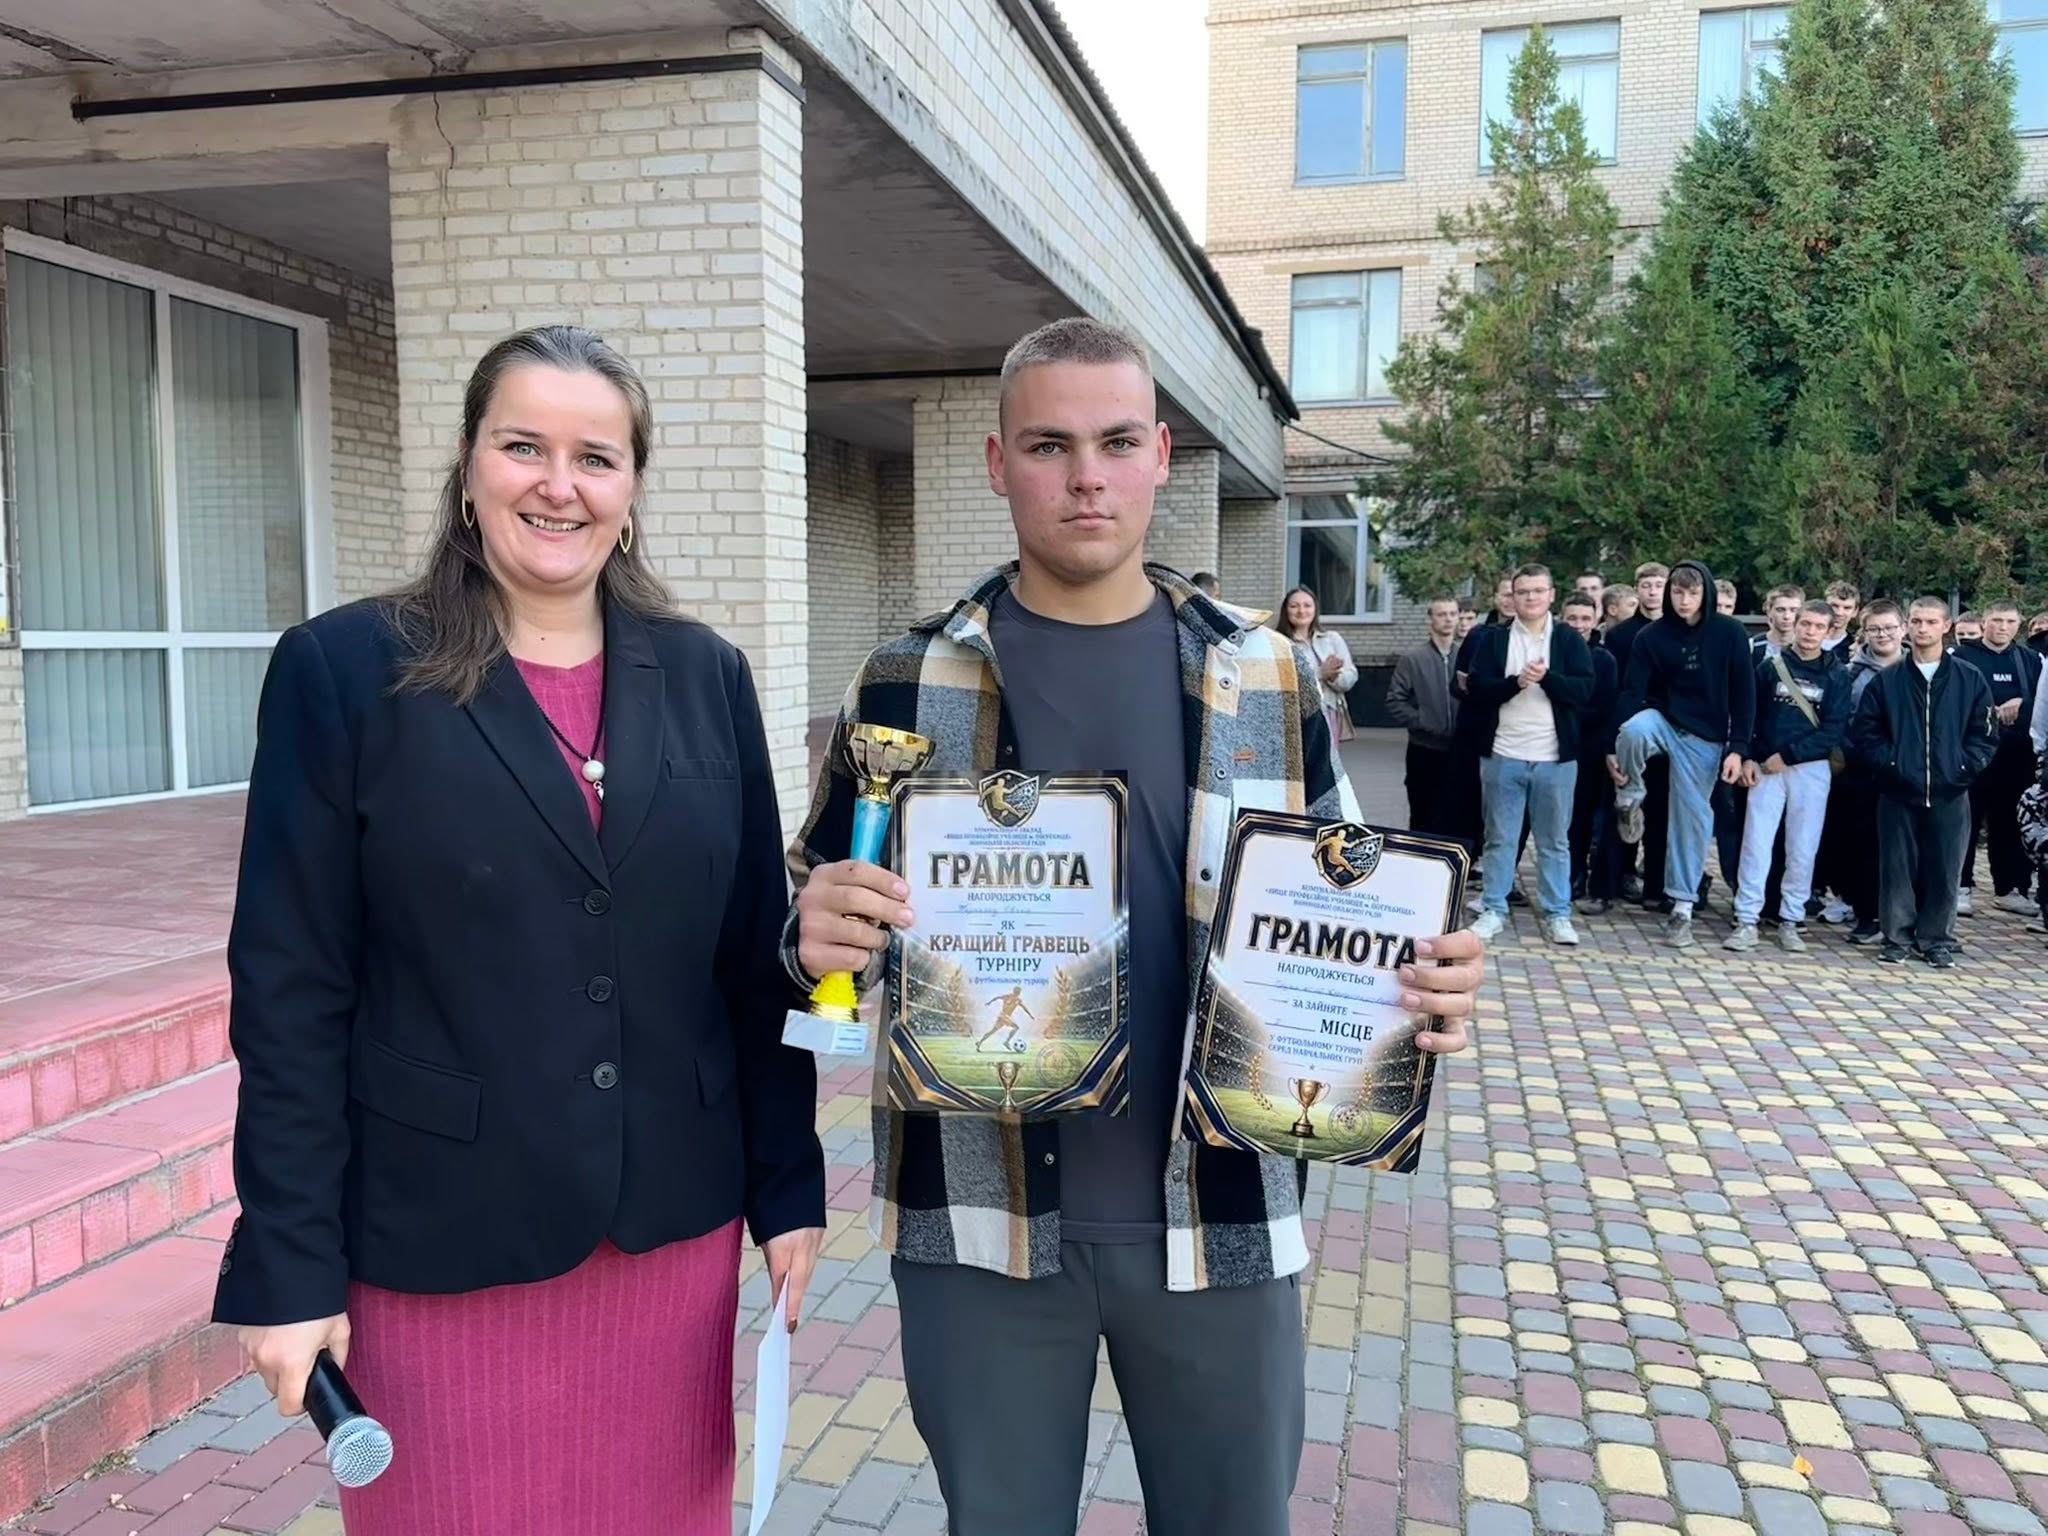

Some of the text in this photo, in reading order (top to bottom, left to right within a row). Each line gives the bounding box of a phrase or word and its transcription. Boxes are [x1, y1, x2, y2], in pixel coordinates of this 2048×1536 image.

[928, 851, 1093, 889] ГРАМОТА
[967, 892, 1051, 902] НАГОРОДЖУЄТЬСЯ
[1001, 920, 1015, 930] ЯК
[929, 932, 1090, 956] КРАЩИЙ ГРАВЕЦЬ
[1246, 912, 1419, 971] ГРАМОТА
[976, 957, 1042, 972] ТУРНІРУ
[1277, 962, 1375, 986] НАГОРОДЖУЄТЬСЯ
[1291, 999, 1349, 1016] ЗА ЗАЙНЯТЕ
[1320, 1018, 1374, 1042] МІСЦЕ
[1276, 1035, 1335, 1051] ФУТБОЛЬНОМУ
[1292, 1048, 1343, 1063] НАВЧАЛЬНИХ
